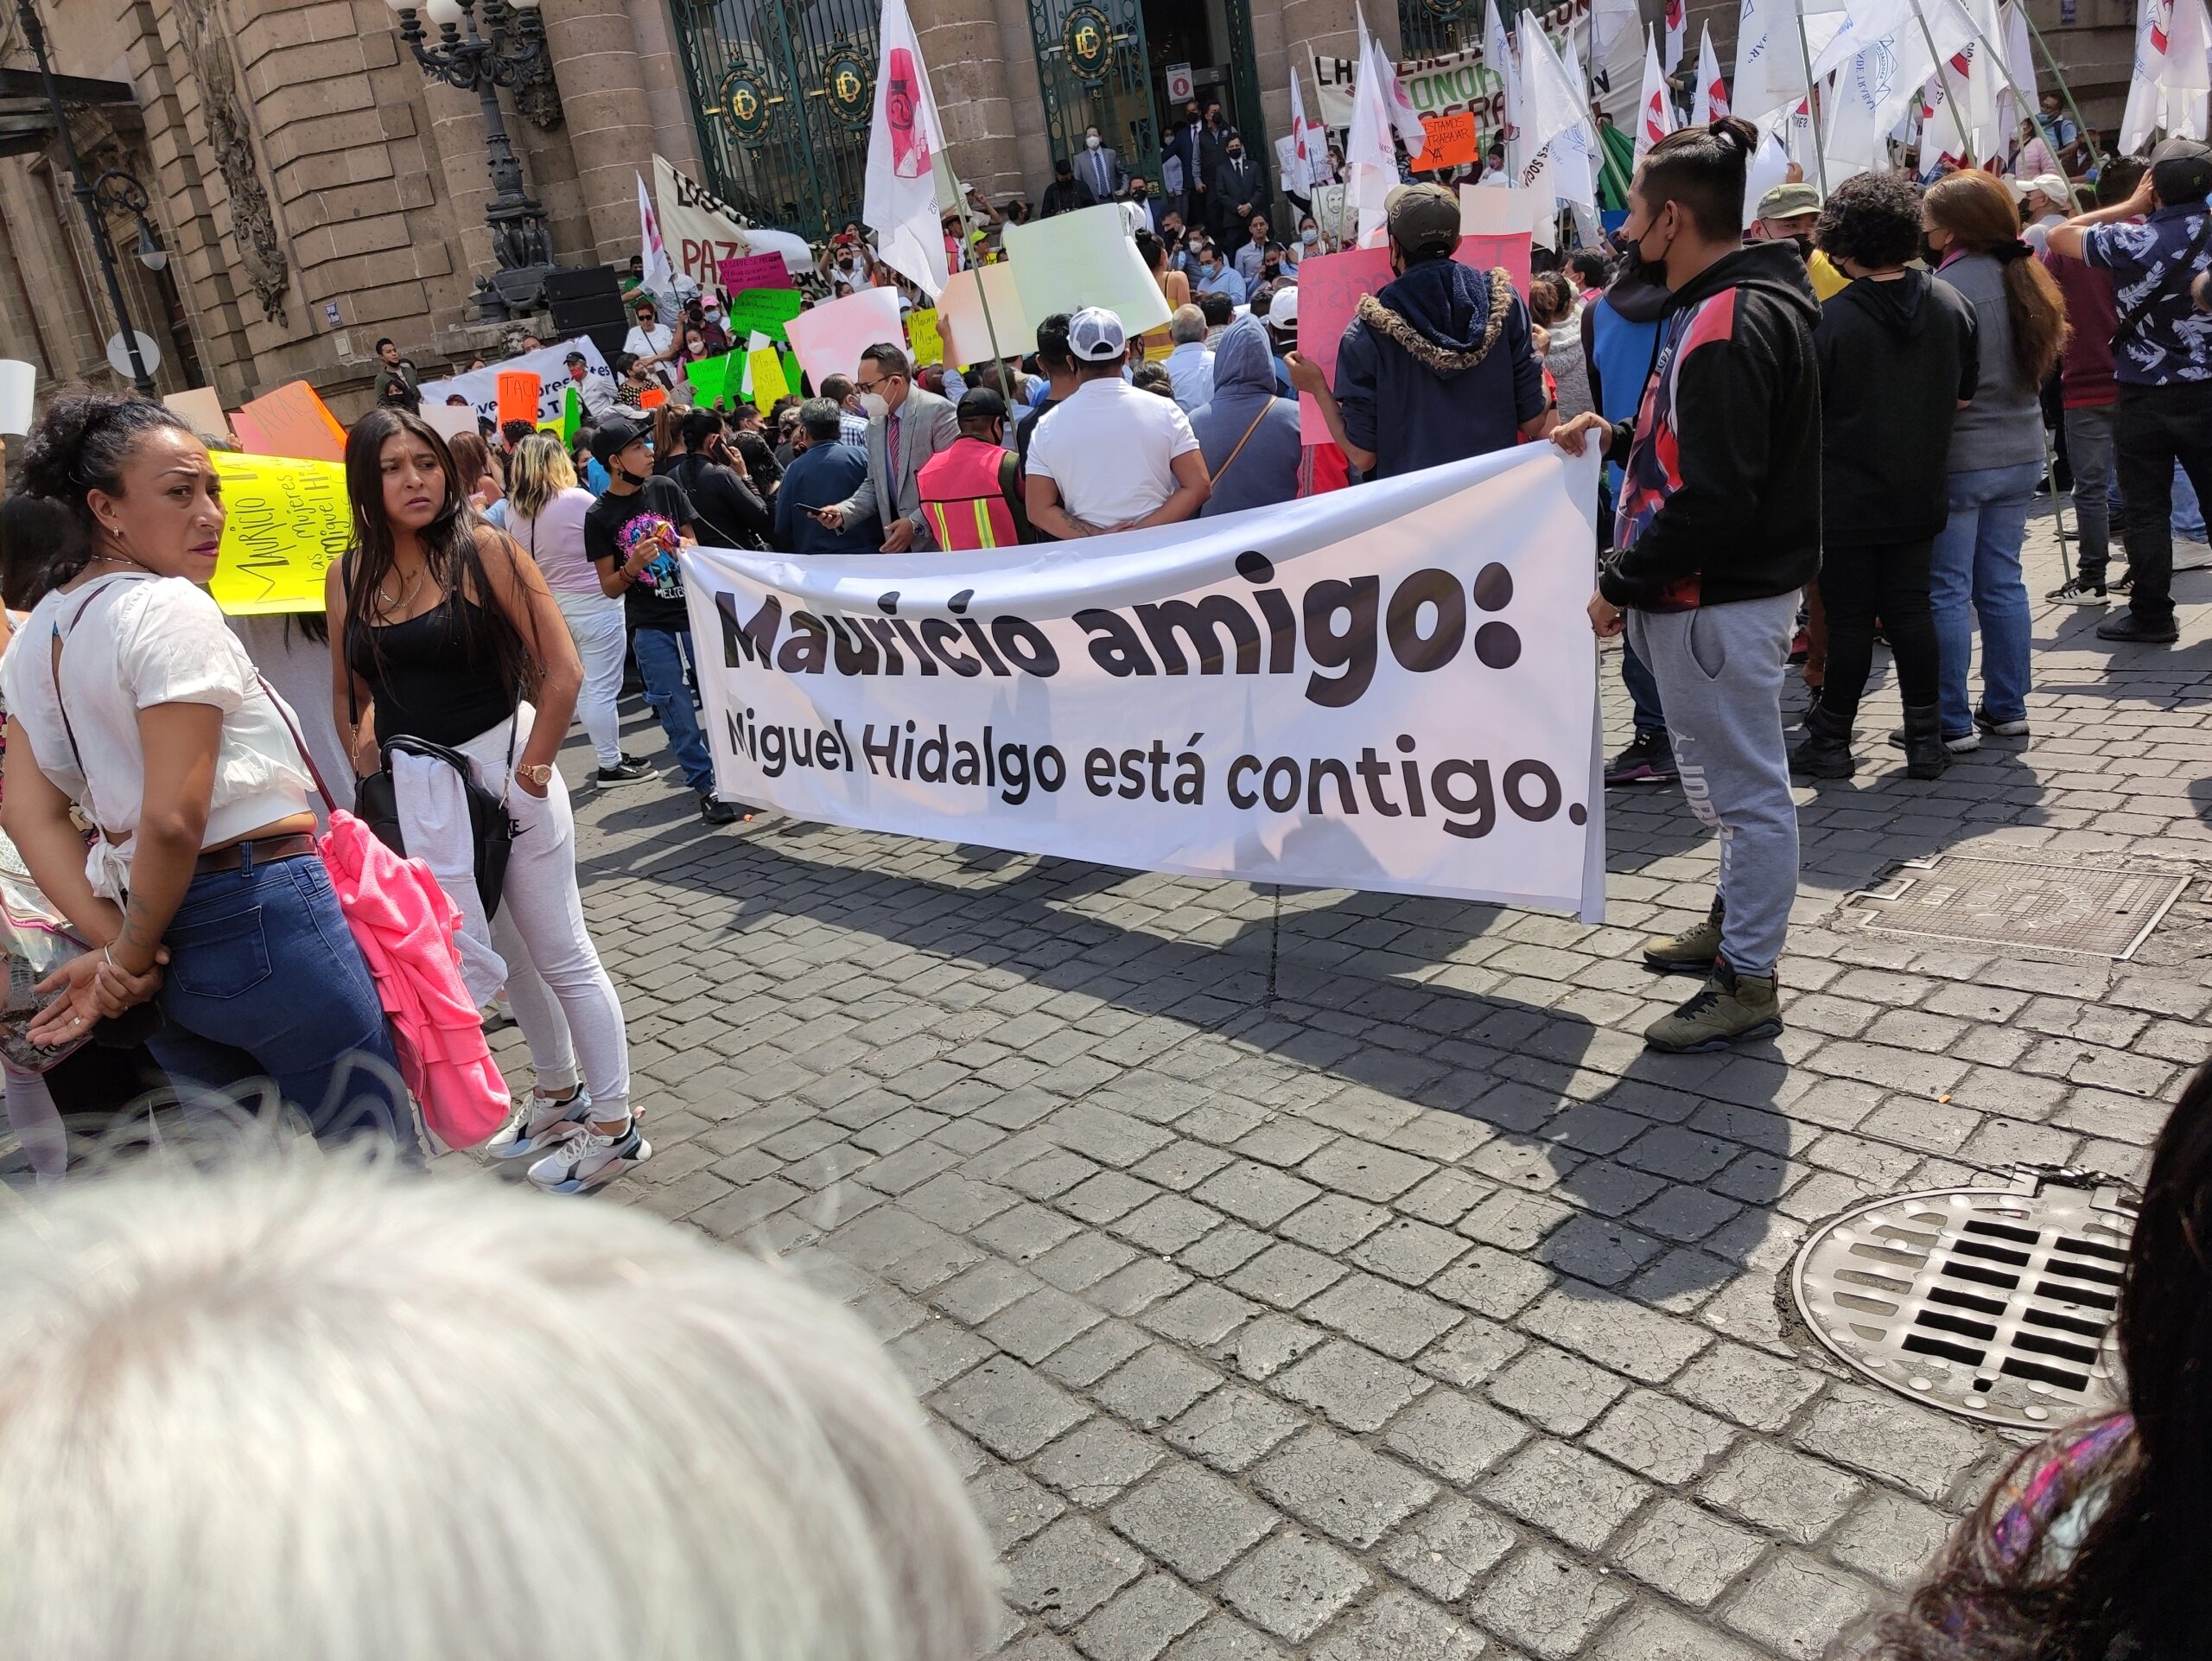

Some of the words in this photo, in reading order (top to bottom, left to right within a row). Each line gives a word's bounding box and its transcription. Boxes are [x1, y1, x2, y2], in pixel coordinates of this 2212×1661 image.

[682, 239, 738, 285] PAZ
[715, 589, 1060, 678] Mauricio
[1071, 550, 1522, 708] amigo:
[726, 707, 854, 778] Miguel
[863, 719, 1066, 805] Hidalgo
[1084, 733, 1205, 806] está
[1227, 734, 1588, 839] contigo.
